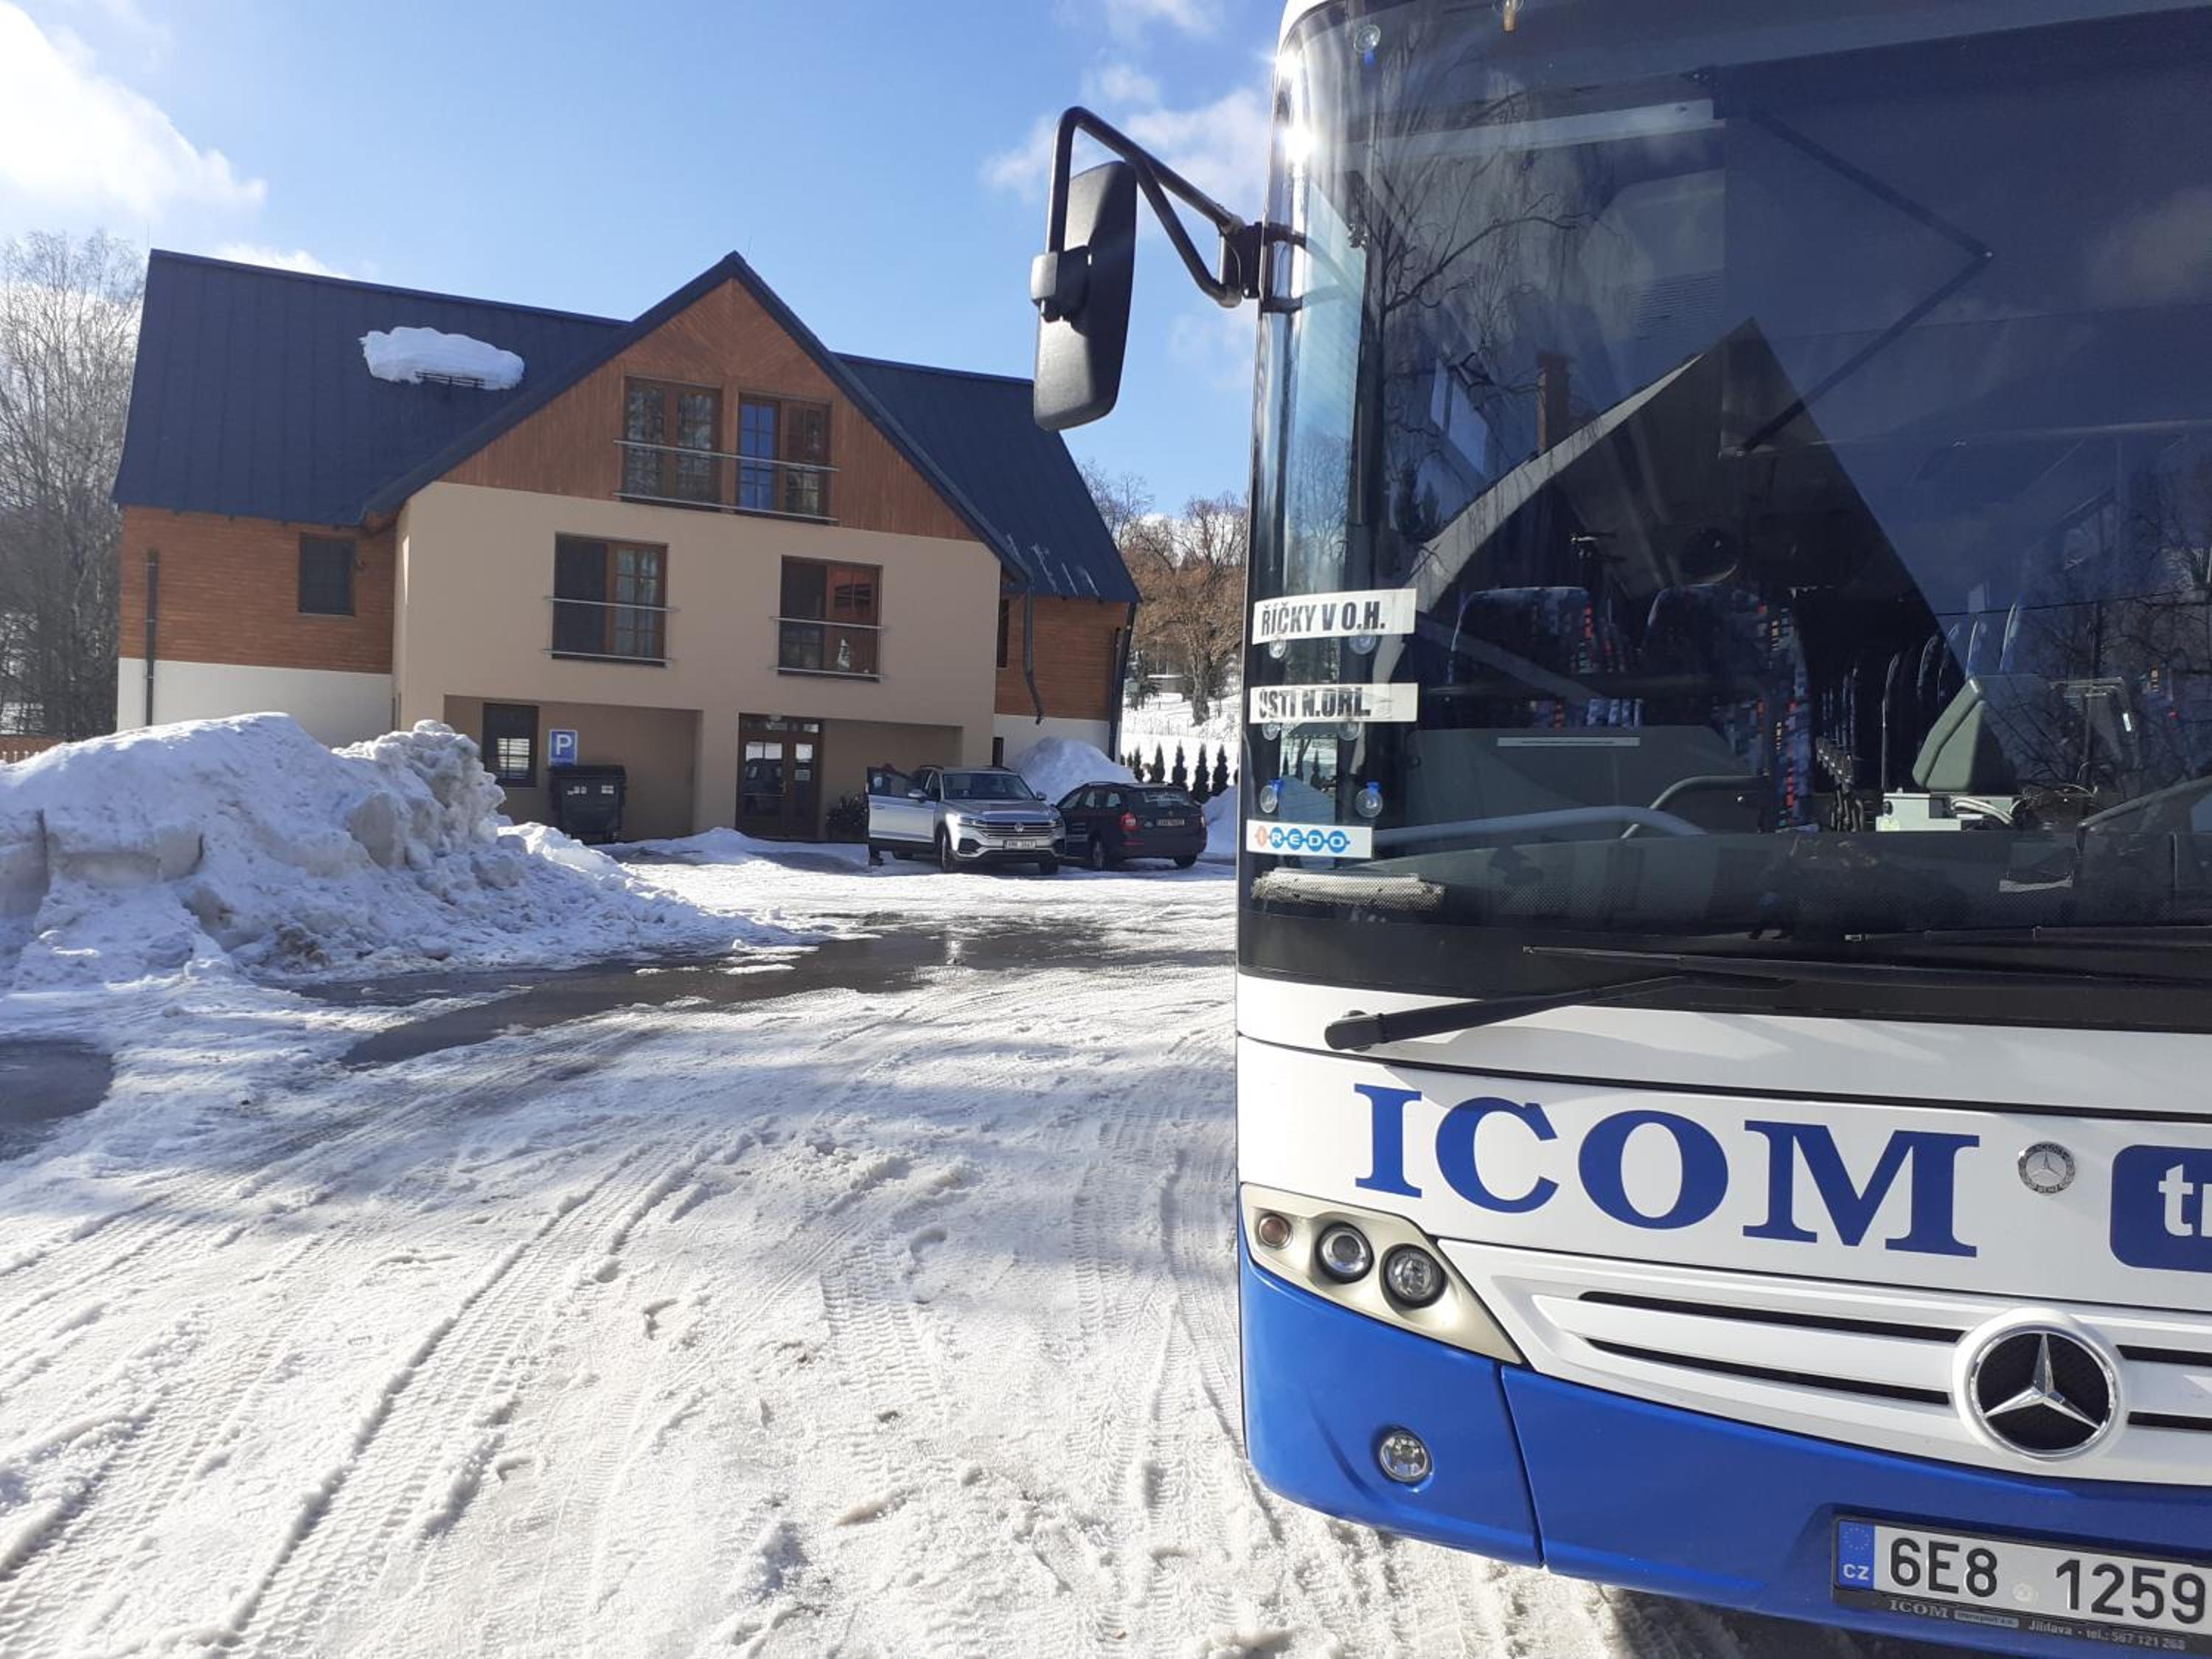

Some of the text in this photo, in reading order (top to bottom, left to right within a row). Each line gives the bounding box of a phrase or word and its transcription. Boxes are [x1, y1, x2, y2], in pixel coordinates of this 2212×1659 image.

[1262, 601, 1385, 636] ŘÍČKY V O.H.
[556, 734, 572, 756] P
[1357, 1085, 1978, 1256] ICOM
[1843, 1563, 1870, 1582] CZ
[1891, 1537, 2206, 1625] 6E8 1259
[1888, 1599, 1949, 1618] ICOM
